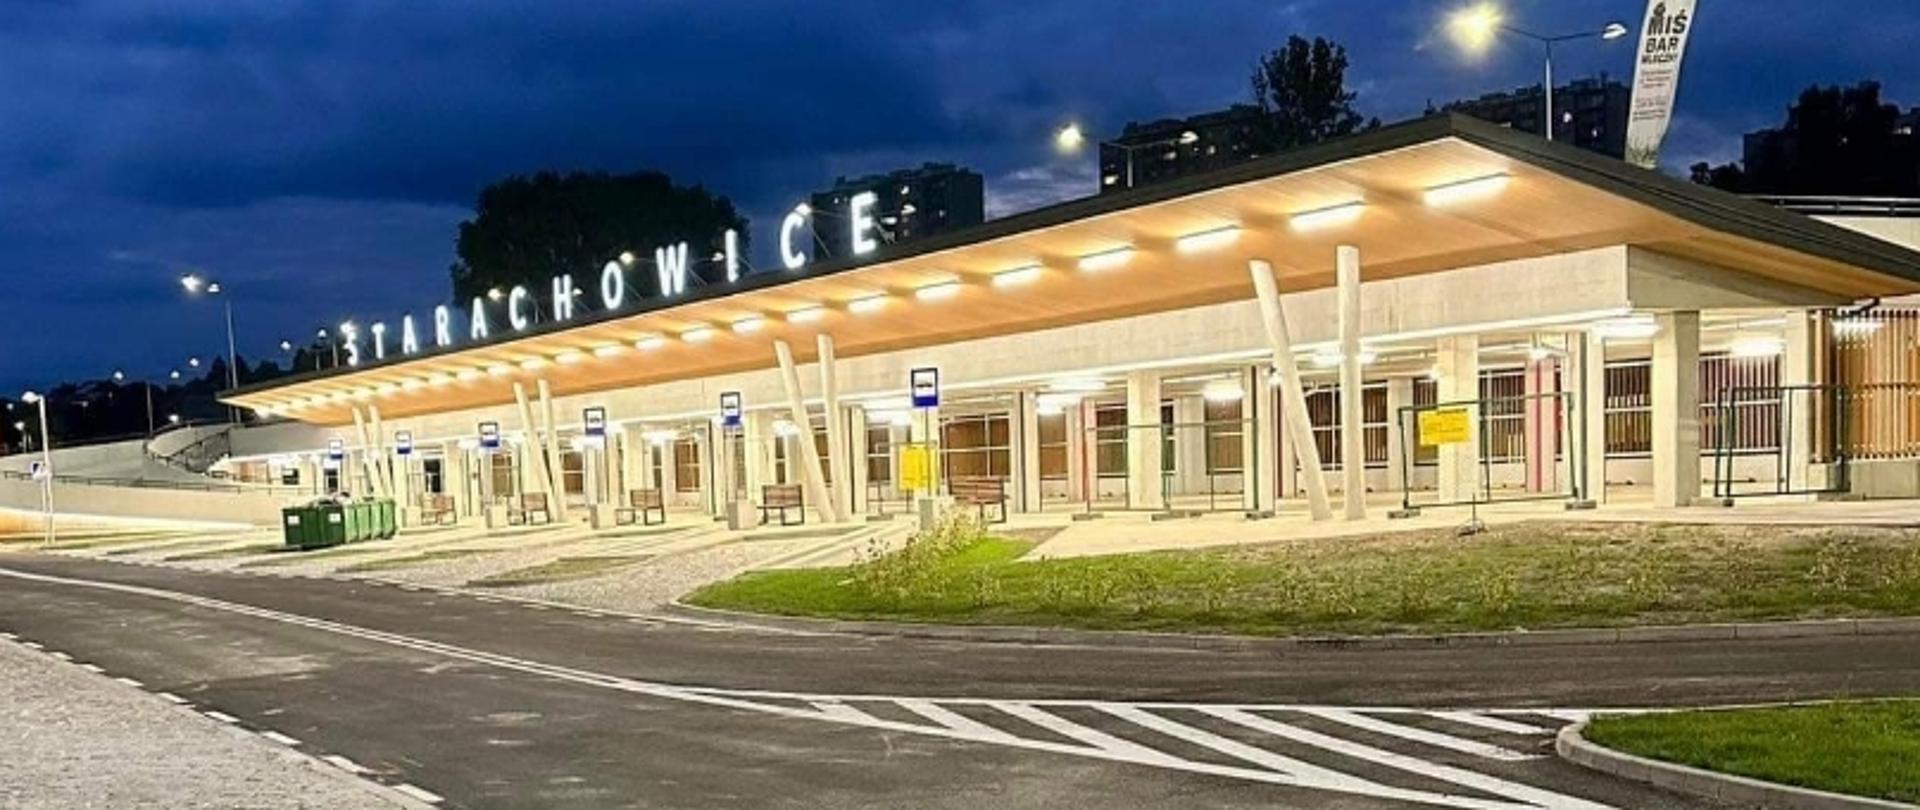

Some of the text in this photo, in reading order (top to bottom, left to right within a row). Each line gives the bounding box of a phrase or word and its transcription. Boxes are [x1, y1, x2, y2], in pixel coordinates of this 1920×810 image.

[1647, 9, 1688, 37] MIŚ
[1645, 37, 1679, 54] BAR
[340, 190, 877, 367] STARACHOWICE
